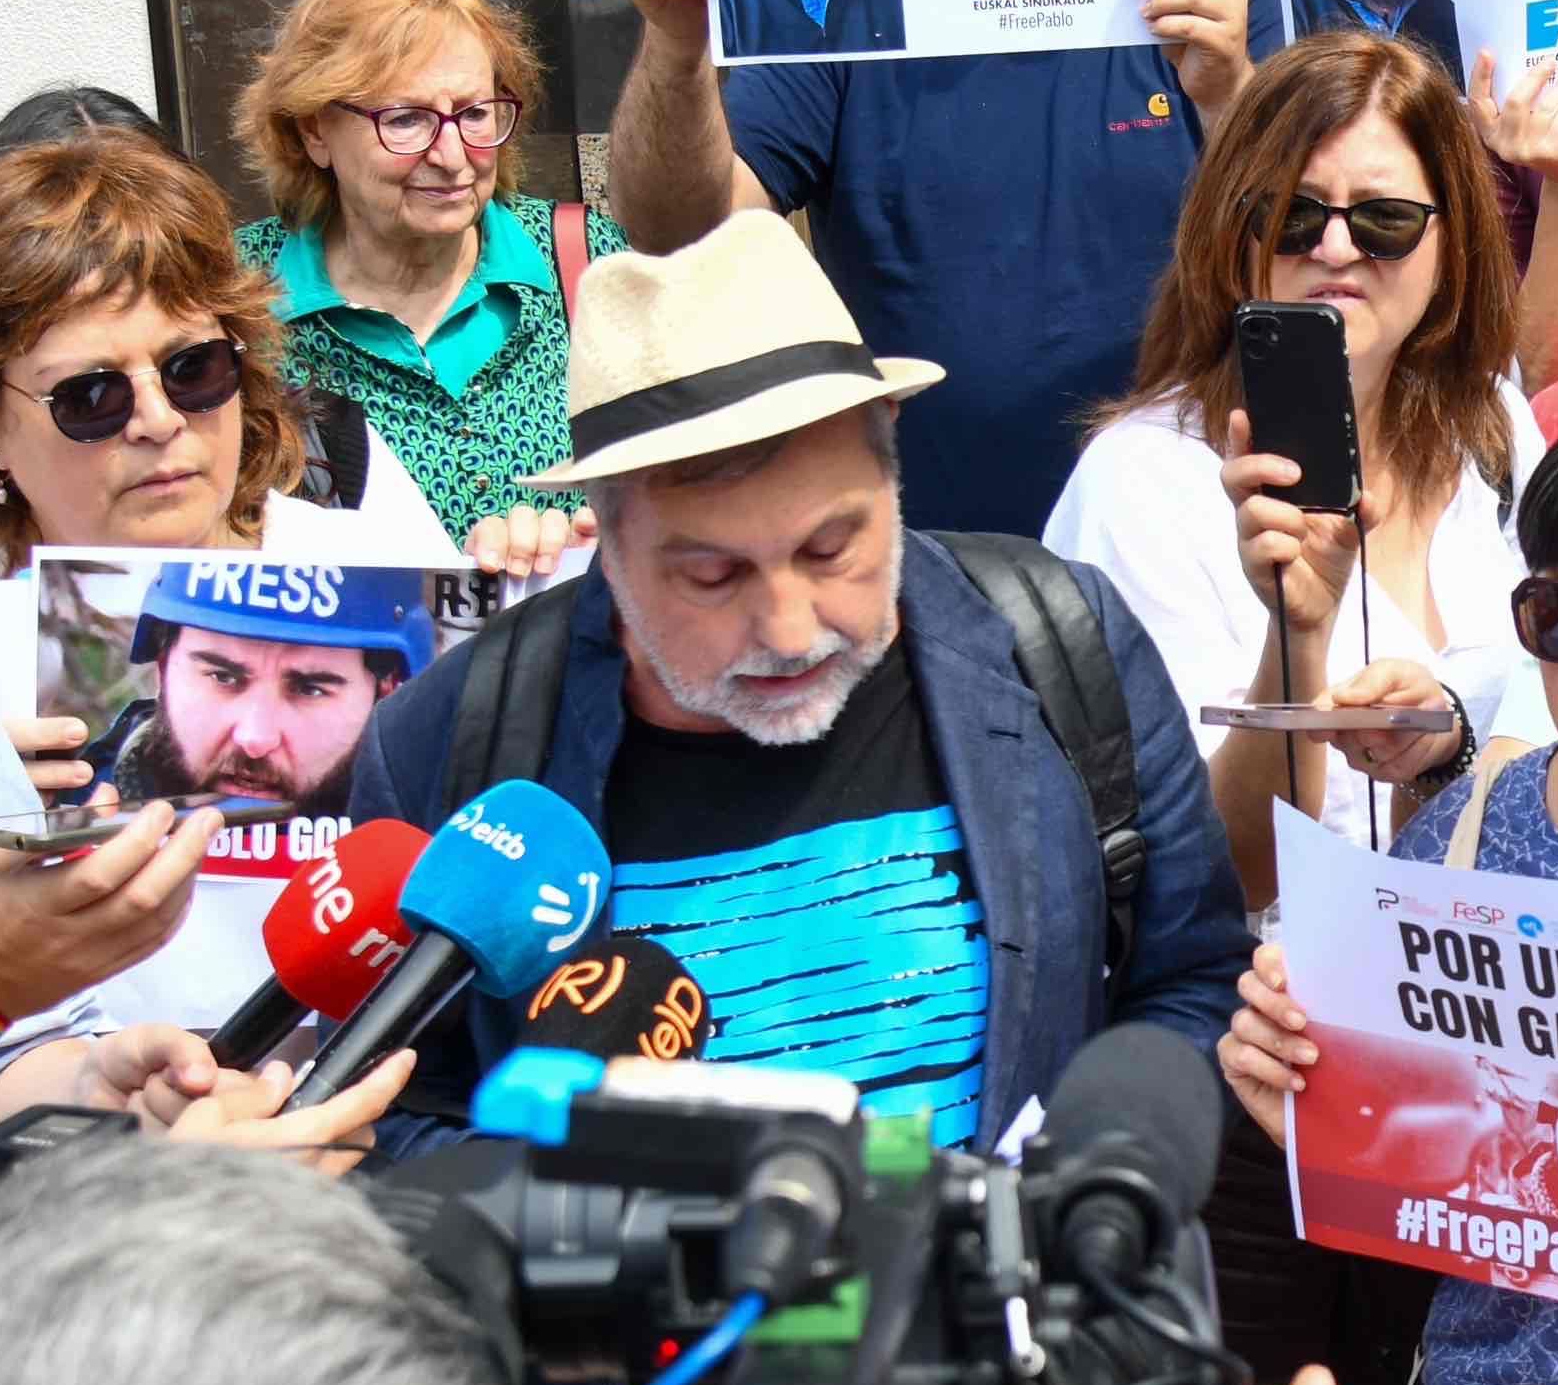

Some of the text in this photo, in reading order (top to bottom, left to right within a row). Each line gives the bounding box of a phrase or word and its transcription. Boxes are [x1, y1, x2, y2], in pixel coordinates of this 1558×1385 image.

[973, 0, 1019, 11] EUSKAL
[999, 11, 1074, 30] #FreePablo
[186, 561, 345, 617] PRESS
[1453, 902, 1506, 926] FeSP
[1397, 921, 1507, 992] POR
[1395, 981, 1504, 1049] CON
